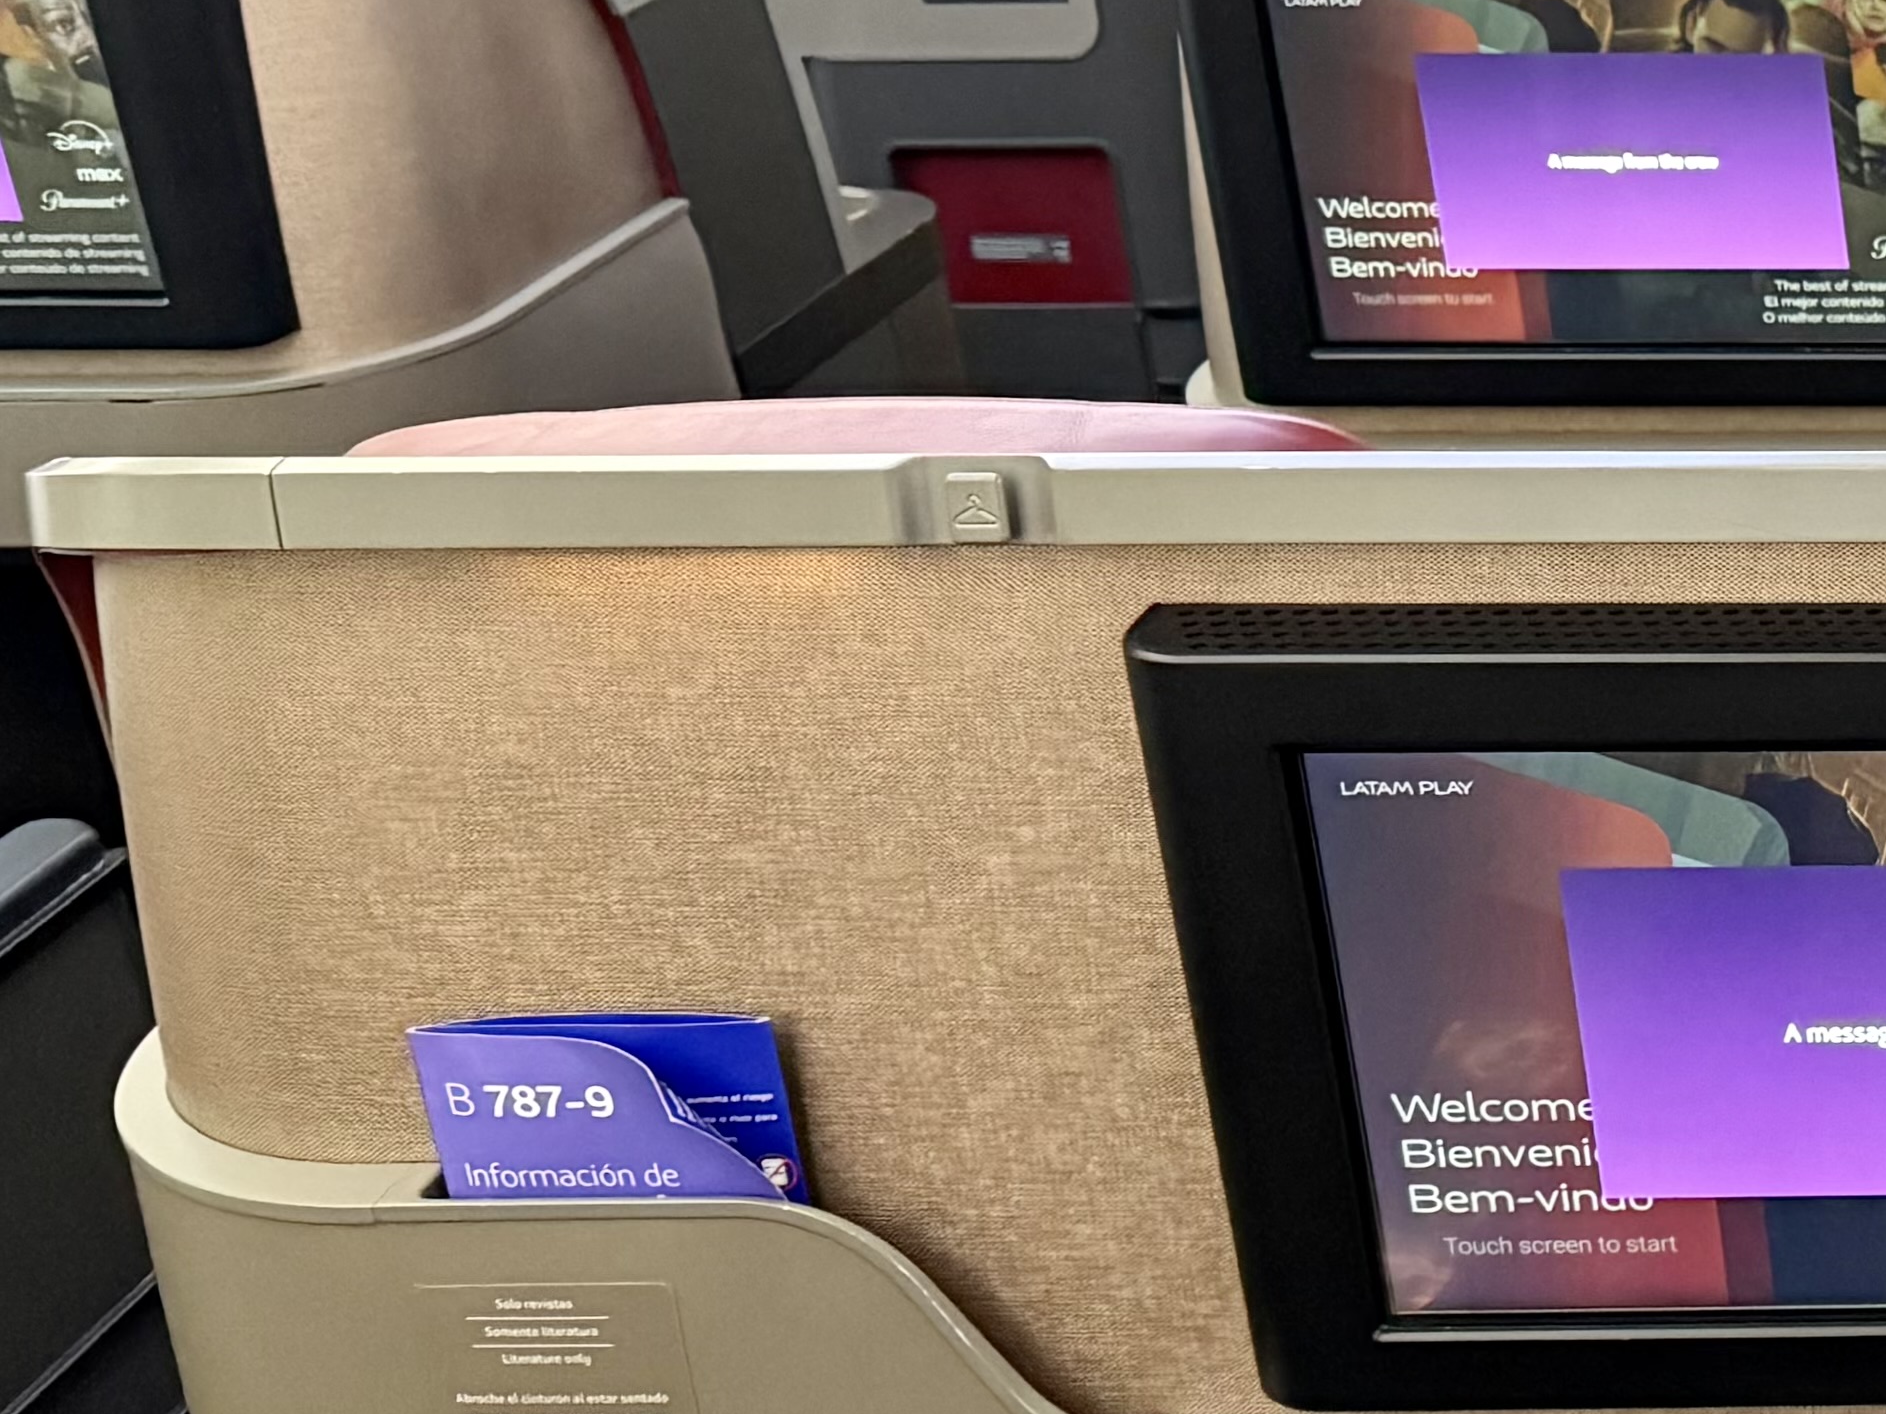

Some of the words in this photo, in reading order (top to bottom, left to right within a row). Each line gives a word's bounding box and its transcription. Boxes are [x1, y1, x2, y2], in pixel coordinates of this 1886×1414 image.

[77, 168, 124, 181] max
[1324, 227, 1444, 249] Bienveni
[1340, 780, 1414, 795] LATAM
[1418, 780, 1473, 795] PLAY
[1783, 1023, 1802, 1043] A
[444, 1082, 475, 1116] B
[482, 1084, 614, 1118] 787-9
[1391, 1090, 1594, 1123] Welcome
[1401, 1137, 1599, 1168] Bienveni
[465, 1162, 635, 1189] Información
[644, 1164, 681, 1188] de
[1442, 1236, 1513, 1256] Touch
[1518, 1239, 1592, 1254] screen
[1597, 1236, 1620, 1254] to
[1626, 1236, 1677, 1253] start
